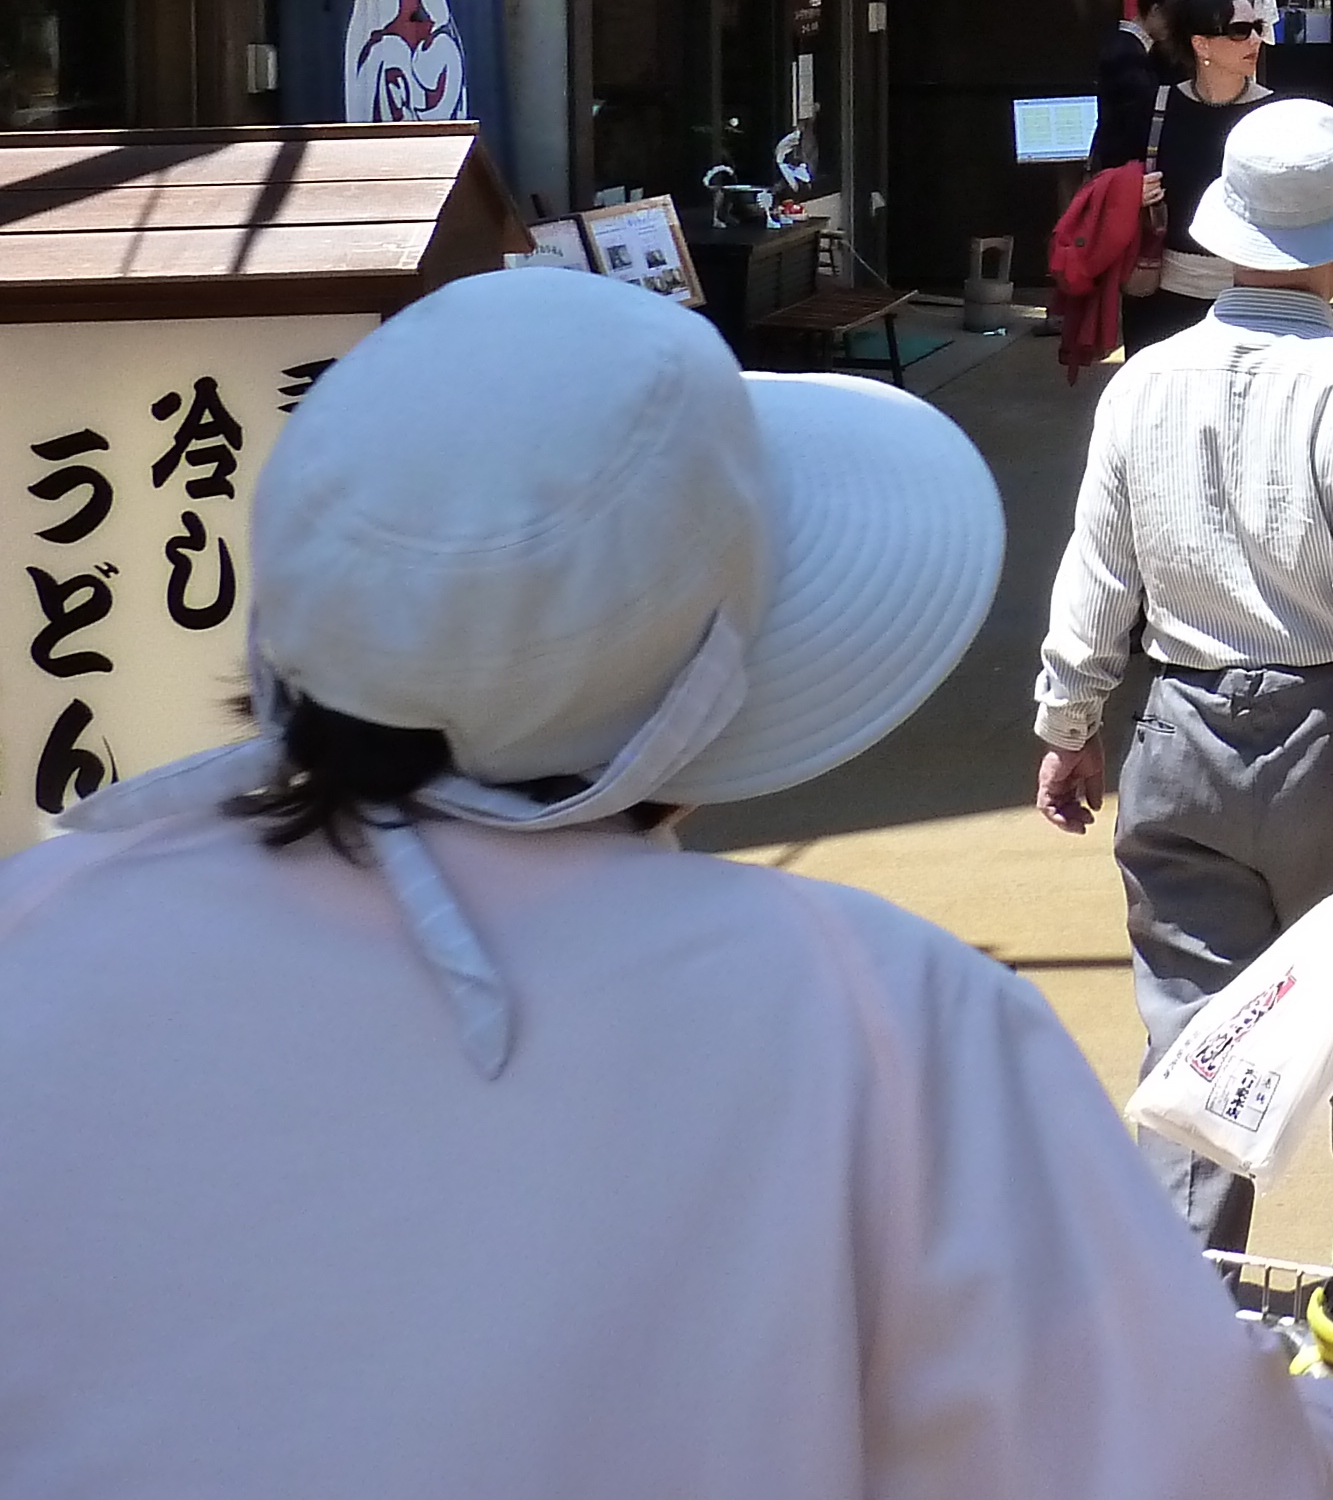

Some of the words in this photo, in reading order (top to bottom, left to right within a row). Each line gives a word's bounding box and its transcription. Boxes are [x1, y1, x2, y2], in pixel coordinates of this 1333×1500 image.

[27, 428, 120, 815] うどん
[151, 376, 243, 631] 冷し
